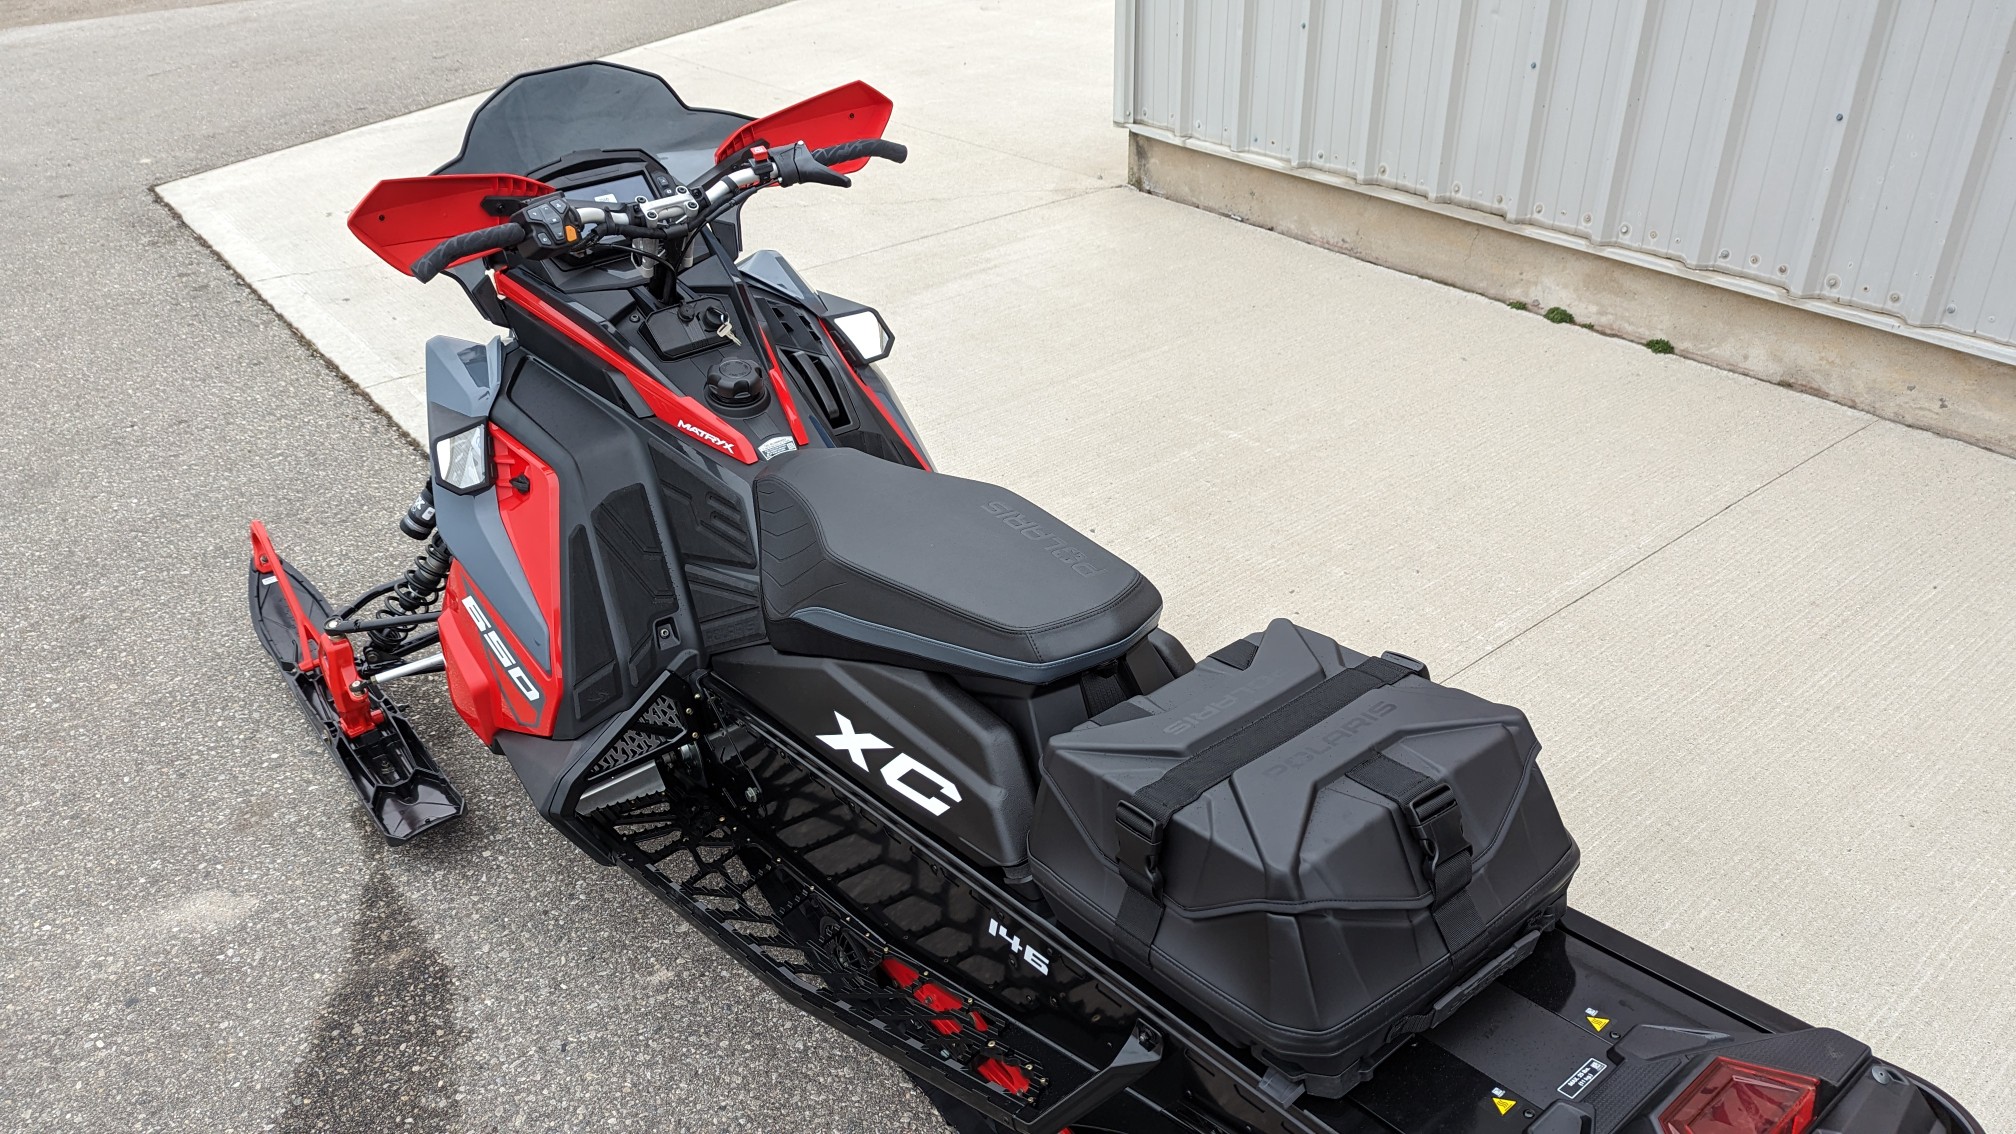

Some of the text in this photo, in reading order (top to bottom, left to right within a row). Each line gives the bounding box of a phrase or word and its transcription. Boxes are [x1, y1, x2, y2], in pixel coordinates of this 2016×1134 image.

[677, 419, 735, 455] MATRYX
[980, 501, 1106, 578] POLARIS
[461, 595, 540, 701] 650
[1163, 671, 1285, 736] OLARIS
[1261, 700, 1398, 778] POLARIS
[815, 710, 963, 817] XC
[988, 917, 1050, 976] 146
